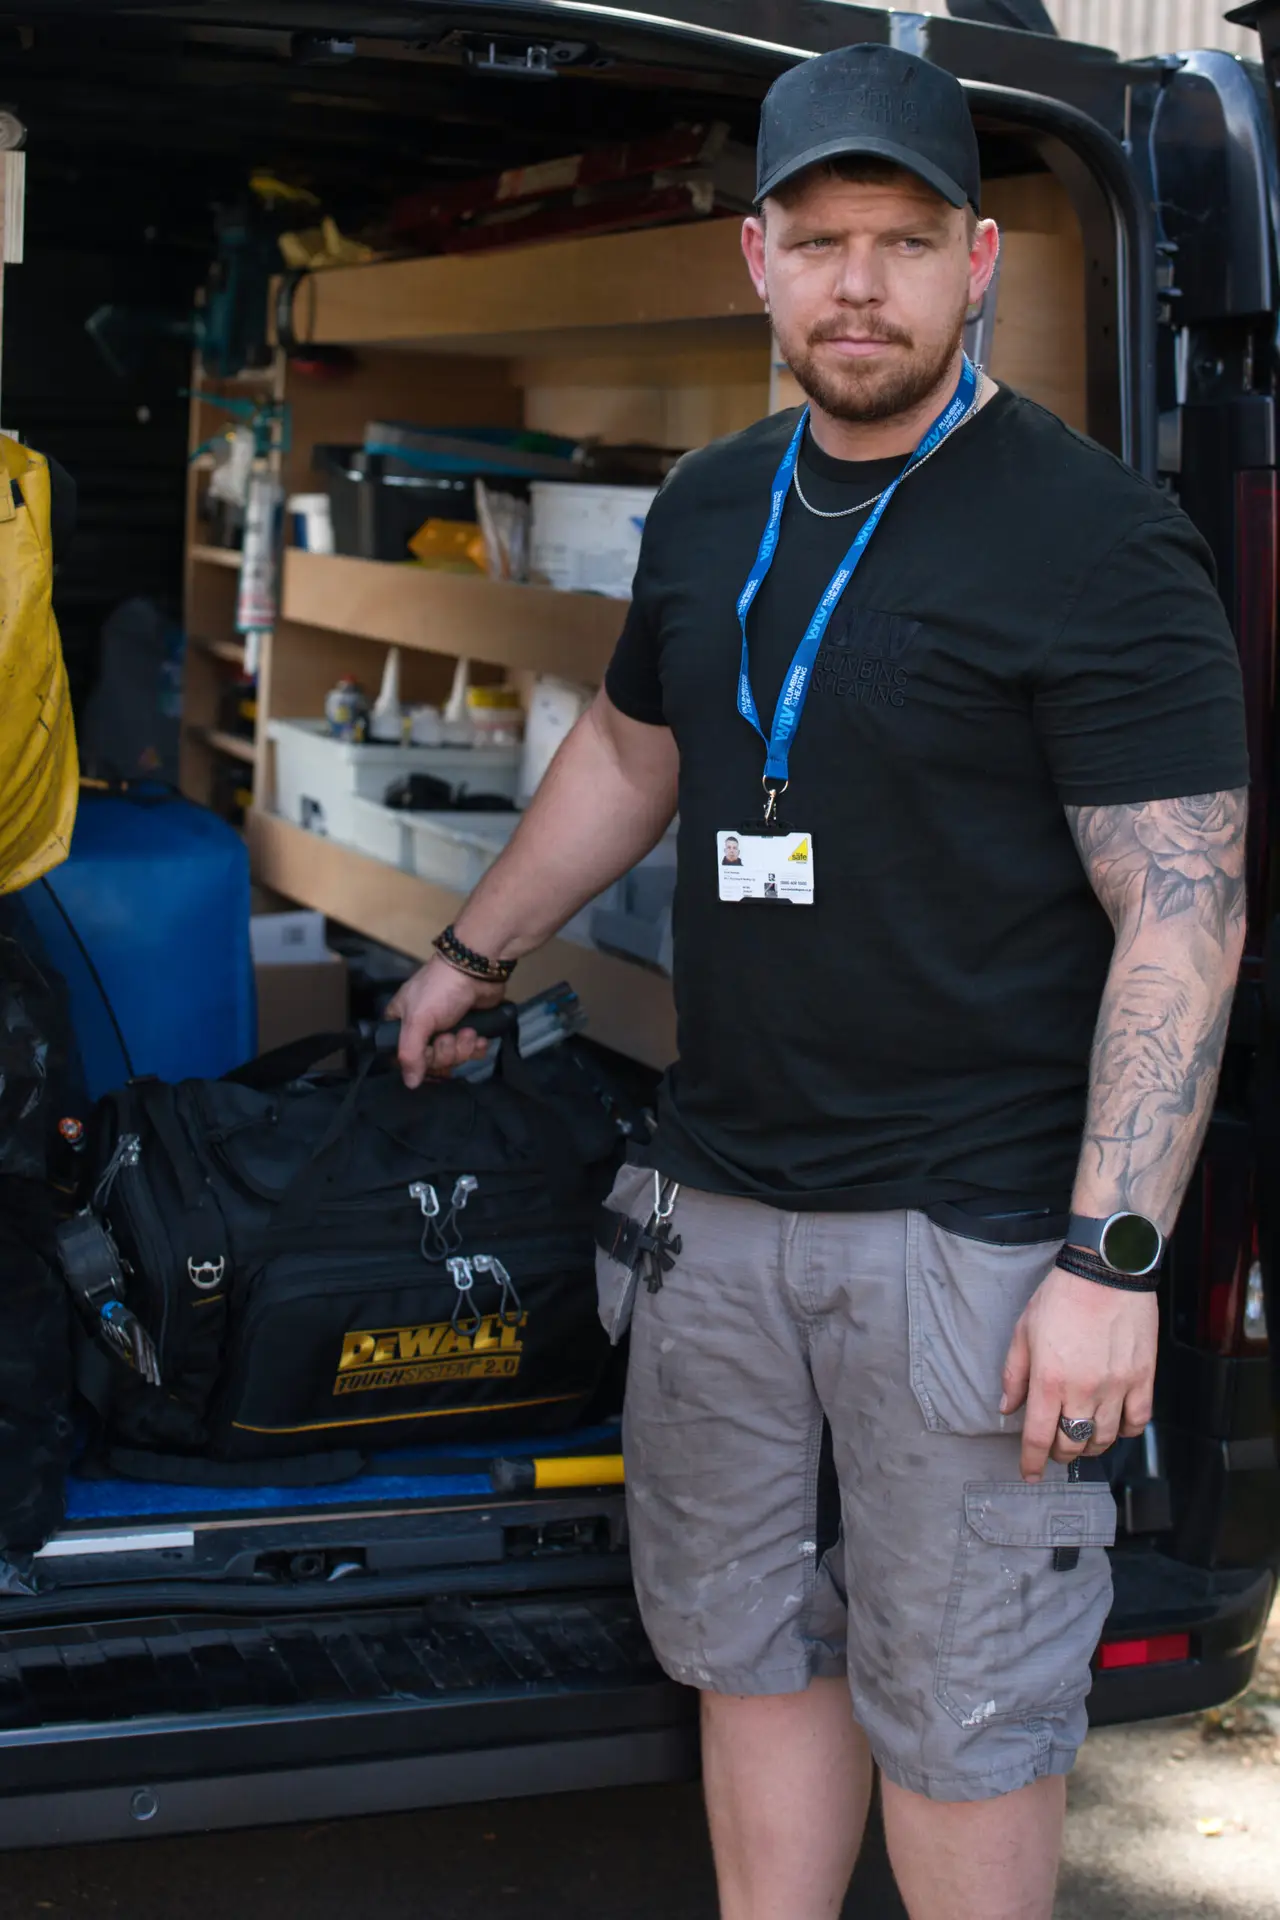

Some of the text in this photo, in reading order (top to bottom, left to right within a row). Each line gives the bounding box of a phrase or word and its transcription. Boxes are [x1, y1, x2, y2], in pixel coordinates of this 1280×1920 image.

[938, 397, 962, 430] PLUMBING
[760, 529, 775, 562] WLV
[854, 515, 877, 546] WLV
[806, 606, 828, 640] WLV
[783, 665, 802, 706] PLUMBING
[775, 705, 796, 741] WLV
[484, 1355, 516, 1377] 2.0
